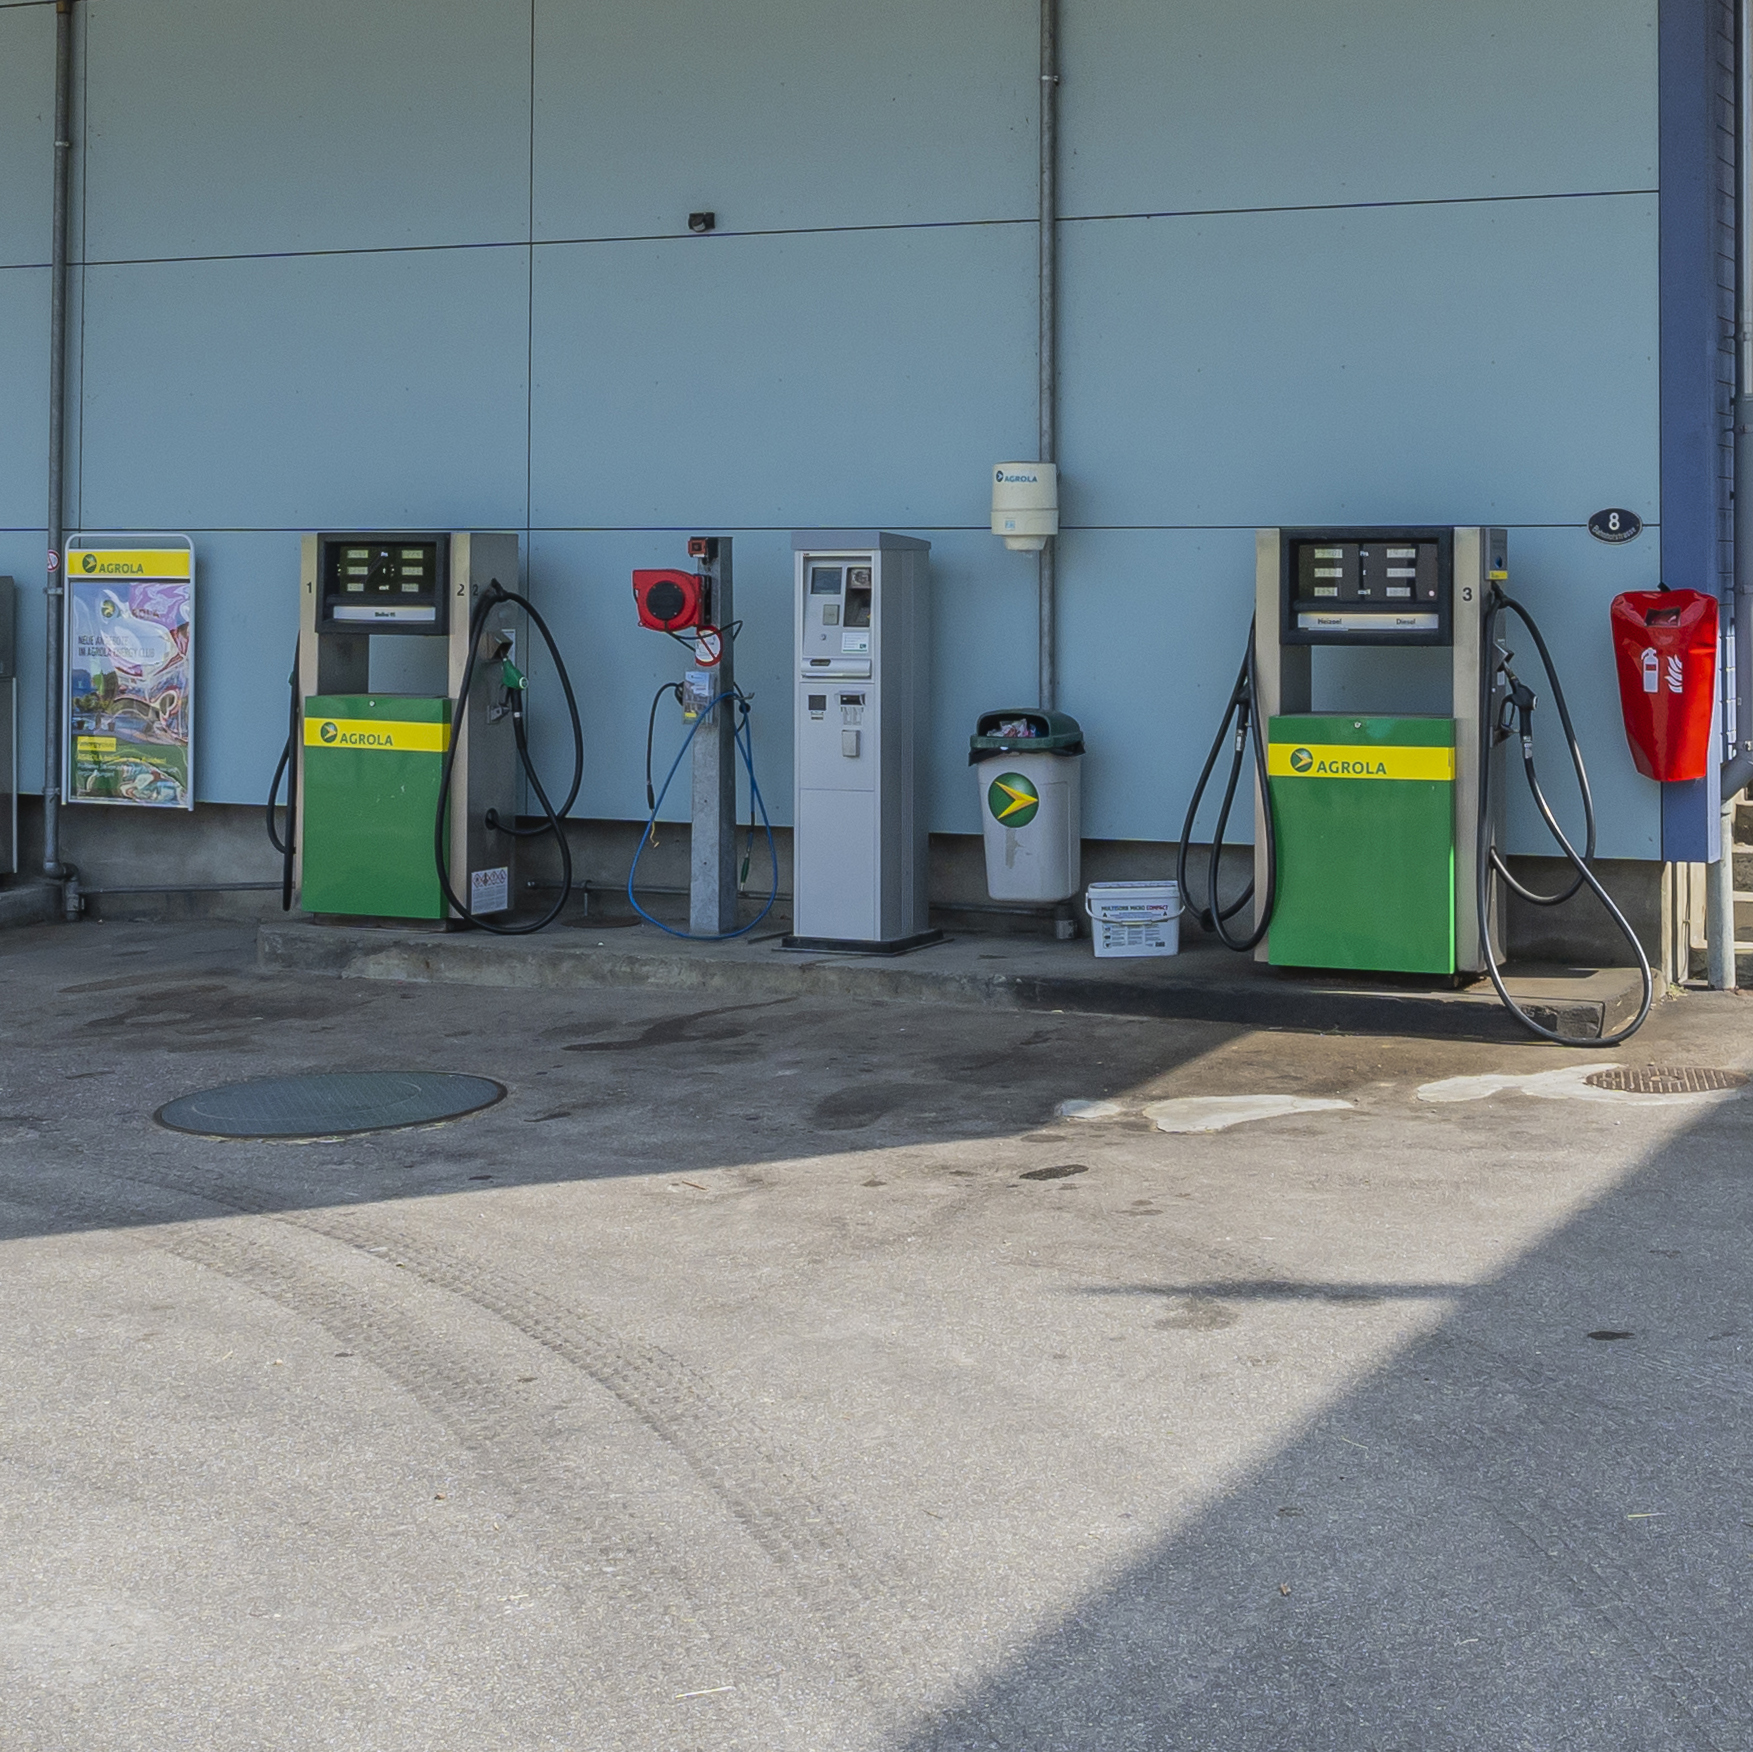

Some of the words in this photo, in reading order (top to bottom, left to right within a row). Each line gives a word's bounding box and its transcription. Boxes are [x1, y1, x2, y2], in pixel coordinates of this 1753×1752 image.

[1004, 475, 1038, 483] AGROLA
[1608, 512, 1620, 531] 8
[98, 563, 144, 574] AGROLA
[306, 581, 312, 593] 1
[456, 584, 465, 596] 2
[472, 584, 479, 596] 2
[1462, 587, 1473, 602] 3
[340, 733, 393, 746] AGROLA
[1317, 760, 1387, 774] AGROLA
